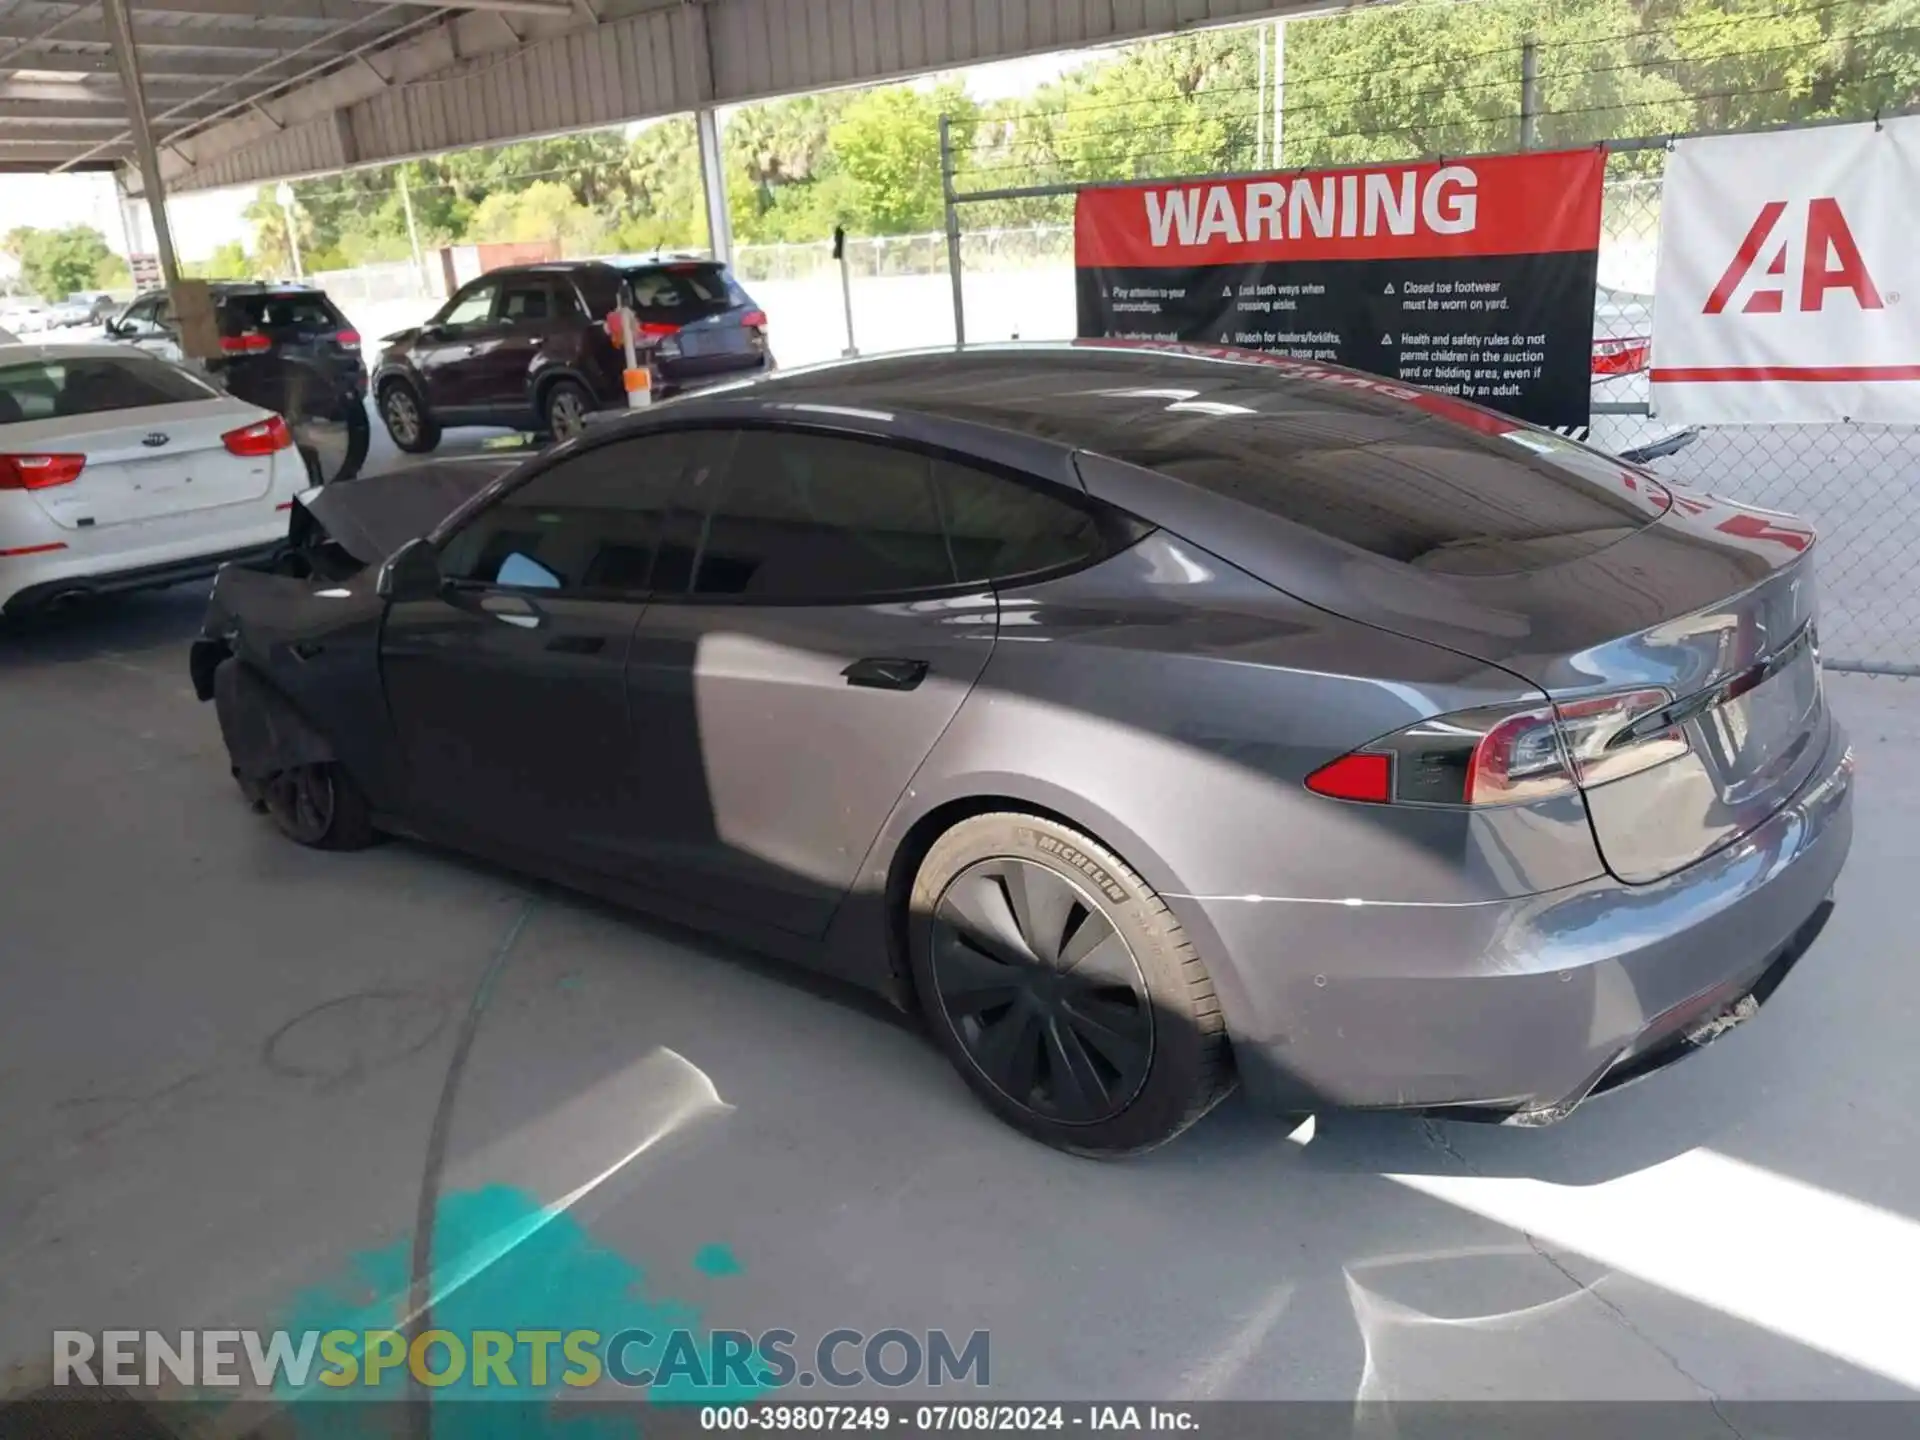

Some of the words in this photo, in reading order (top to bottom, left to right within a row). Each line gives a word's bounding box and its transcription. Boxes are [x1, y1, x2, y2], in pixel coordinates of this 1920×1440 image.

[1144, 165, 1478, 247] WARNING
[1256, 284, 1276, 295] both
[1278, 285, 1300, 297] ways
[1301, 284, 1325, 295] when
[1403, 281, 1434, 294] Closed
[1436, 282, 1452, 293] toe
[1455, 281, 1501, 293] footwear
[1237, 300, 1271, 313] crossing
[1403, 299, 1426, 310] must
[1427, 298, 1439, 310] be
[1441, 299, 1468, 310] worn
[1470, 299, 1483, 310] on
[1485, 297, 1509, 311] yard.
[1235, 332, 1262, 343] Watch
[1264, 331, 1276, 342] for
[1401, 333, 1430, 345] Health
[1432, 333, 1450, 345] and
[1452, 333, 1481, 348] safety
[1483, 333, 1509, 345] rules
[1512, 333, 1524, 345] do
[1526, 334, 1546, 345] not
[1290, 347, 1313, 358] loose
[1314, 349, 1338, 360] parts,
[1400, 351, 1429, 362] permit
[1431, 351, 1468, 362] children
[1470, 351, 1480, 362] in
[1482, 351, 1500, 362] the
[1502, 351, 1544, 362] auction
[1399, 366, 1420, 379] yard
[1422, 368, 1432, 378] or
[1435, 366, 1471, 381] bidding
[1474, 368, 1500, 380] area,
[1503, 368, 1531, 379] even
[1533, 366, 1542, 378] if
[1462, 384, 1475, 397] by
[1478, 385, 1490, 395] an
[1492, 384, 1522, 396] adult.
[1038, 835, 1126, 901] MICHELIN
